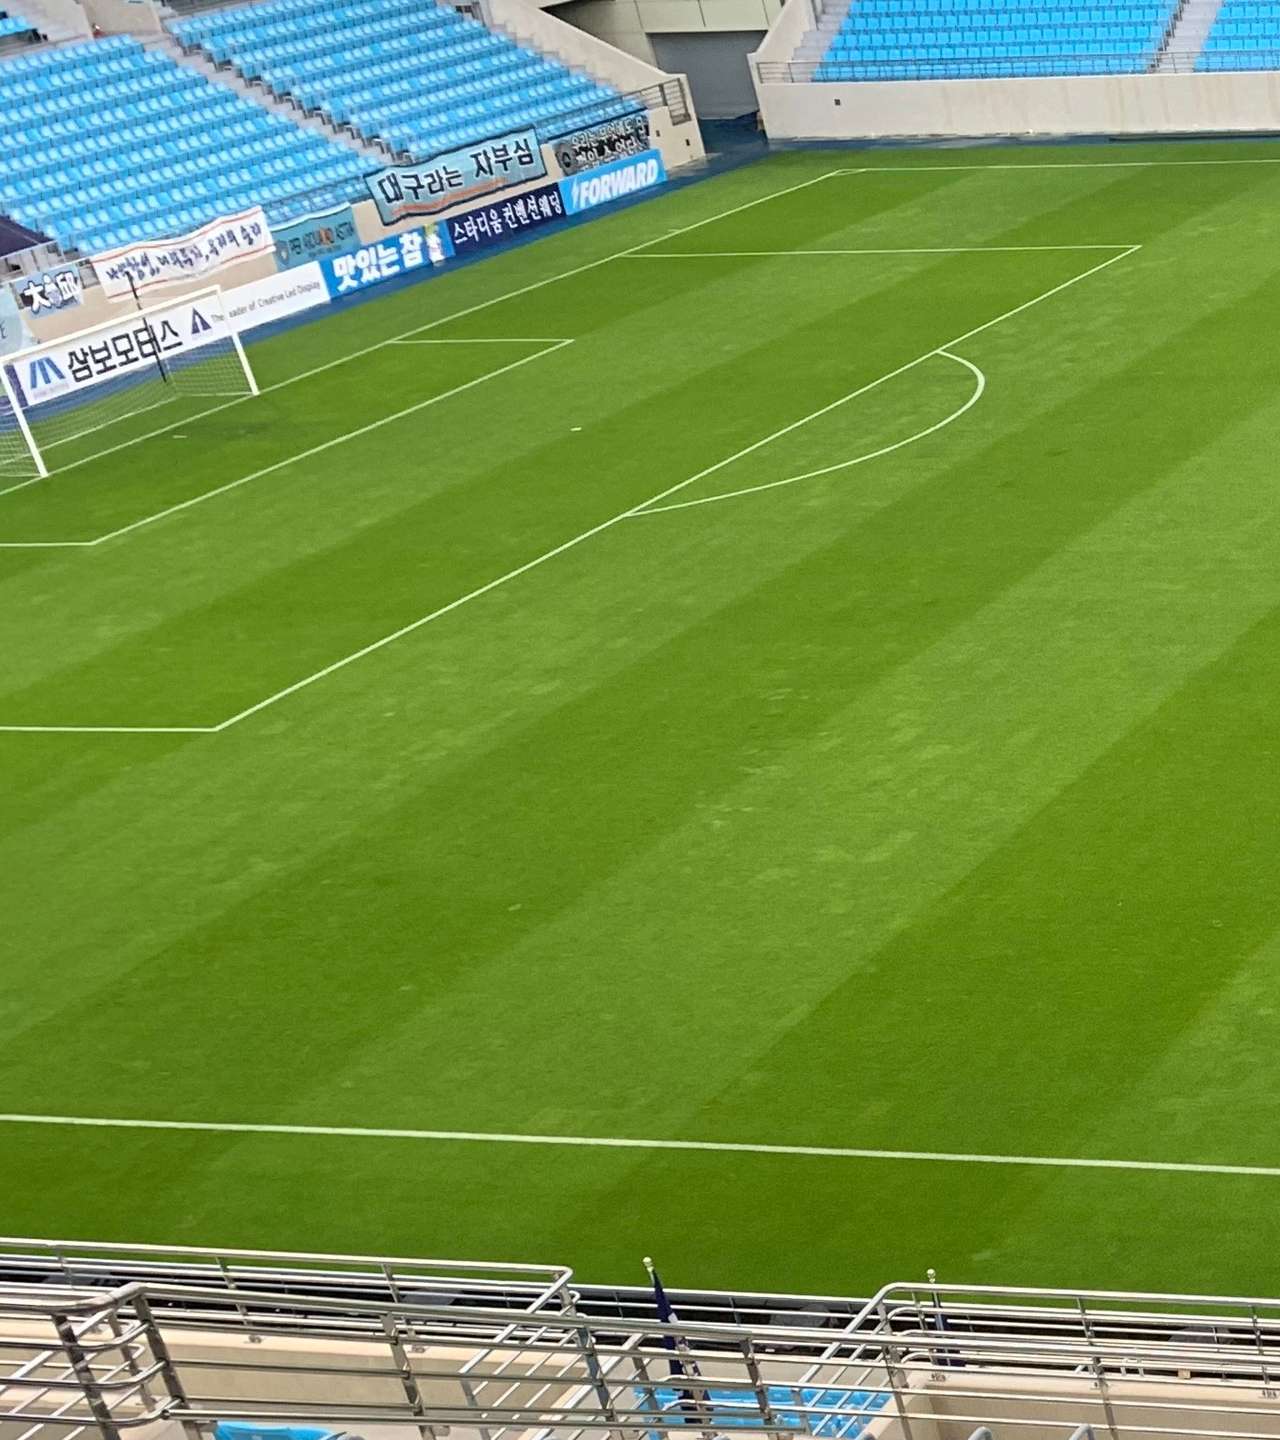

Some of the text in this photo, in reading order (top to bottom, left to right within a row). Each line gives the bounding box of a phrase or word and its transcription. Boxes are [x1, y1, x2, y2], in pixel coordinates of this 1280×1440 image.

[378, 166, 462, 204] 대구라는
[470, 137, 535, 178] 자부심
[579, 158, 659, 207] FORWARD
[453, 212, 503, 244] 스타디움
[332, 243, 401, 292] 맛있는
[399, 231, 424, 269] 참
[67, 319, 183, 383] 삼보모터스
